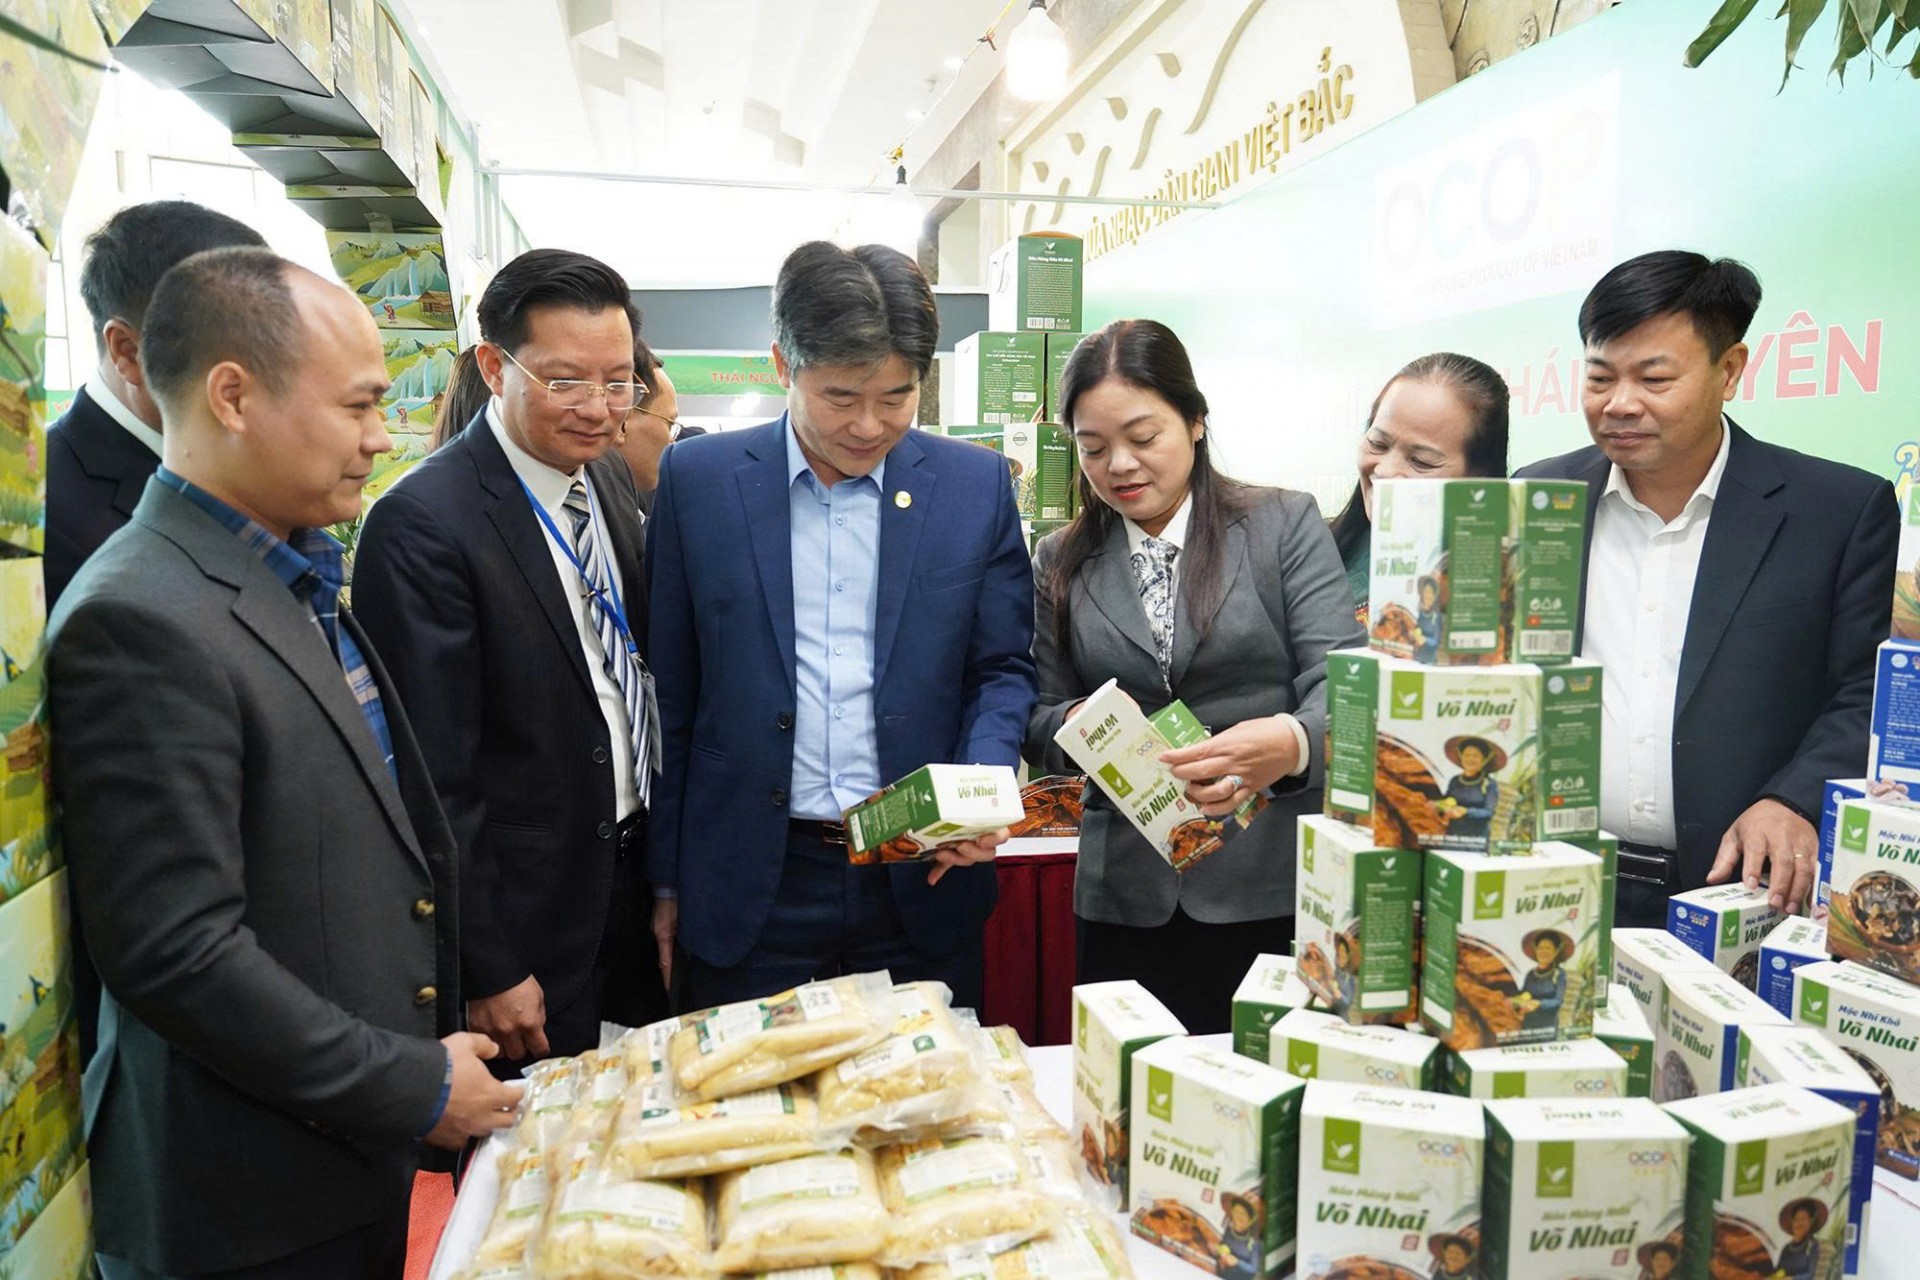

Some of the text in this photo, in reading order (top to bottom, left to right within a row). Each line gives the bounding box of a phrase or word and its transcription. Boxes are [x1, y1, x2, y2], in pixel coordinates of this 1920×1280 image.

[1191, 138, 1240, 201] GIAN
[1243, 101, 1295, 176] VIỆT
[1297, 45, 1355, 144] BẮC
[1541, 237, 1599, 268] VIETNAM
[1505, 309, 1884, 418] HÁI YÊN
[1436, 698, 1517, 718] Võ Nhai
[957, 783, 998, 799] Võ Nhai
[1136, 806, 1154, 828] Võ
[1149, 781, 1179, 816] Nhai
[1877, 842, 1902, 860] Võ
[1312, 900, 1335, 928] Nhai
[1515, 887, 1584, 914] Võ Nhai
[1744, 925, 1760, 944] Võ
[1628, 980, 1653, 1005] Nhai
[1838, 1004, 1901, 1027] Mộc Nhĩ Khô
[1671, 1021, 1715, 1060] Võ Nhai
[1838, 1018, 1920, 1052] Võ Nhai
[1417, 1139, 1466, 1156] OCOP
[1628, 1150, 1673, 1165] OCOP
[1143, 1141, 1167, 1166] Võ
[1169, 1152, 1221, 1187] Nhai
[1775, 1161, 1798, 1186] Võ
[1798, 1147, 1840, 1179] Nhai
[1316, 1201, 1430, 1231] Võ Nhai
[1529, 1220, 1640, 1252] Võ Nhai
